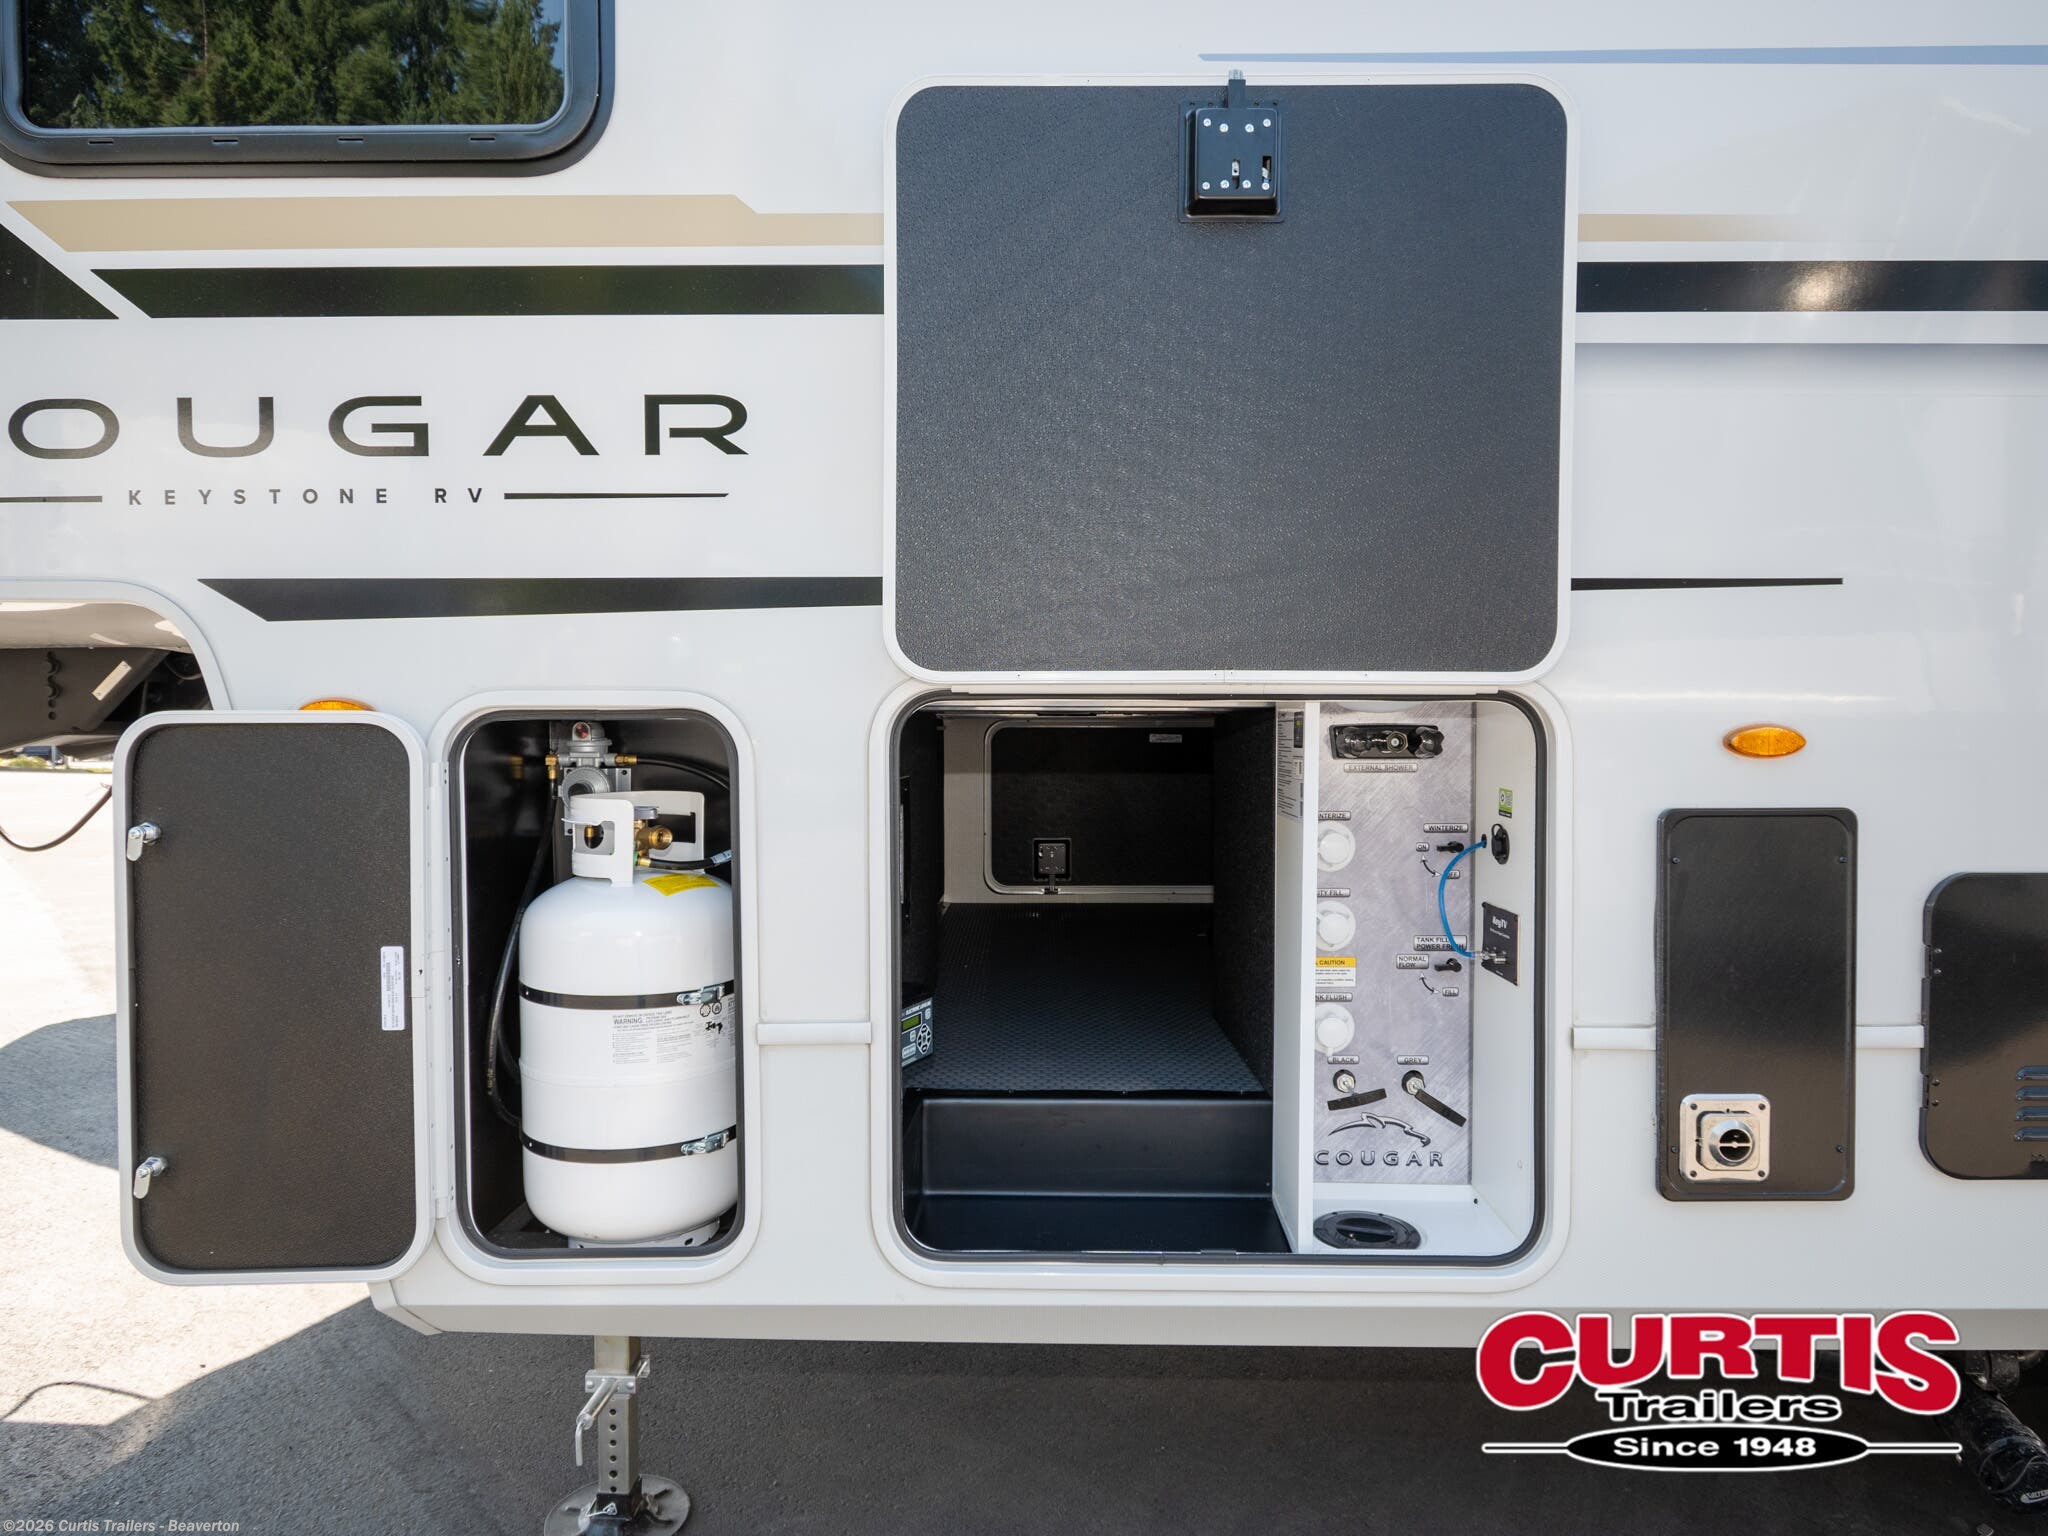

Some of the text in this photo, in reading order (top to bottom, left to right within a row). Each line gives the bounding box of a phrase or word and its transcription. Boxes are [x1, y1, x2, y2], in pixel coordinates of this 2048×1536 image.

[127, 487, 484, 506] KEYSTONE RV
[1348, 764, 1414, 772] EXTERNAL SHOWER
[1428, 824, 1463, 832] WINTERIZE
[1416, 943, 1441, 951] POWER
[1314, 1150, 1443, 1167] COUGAR
